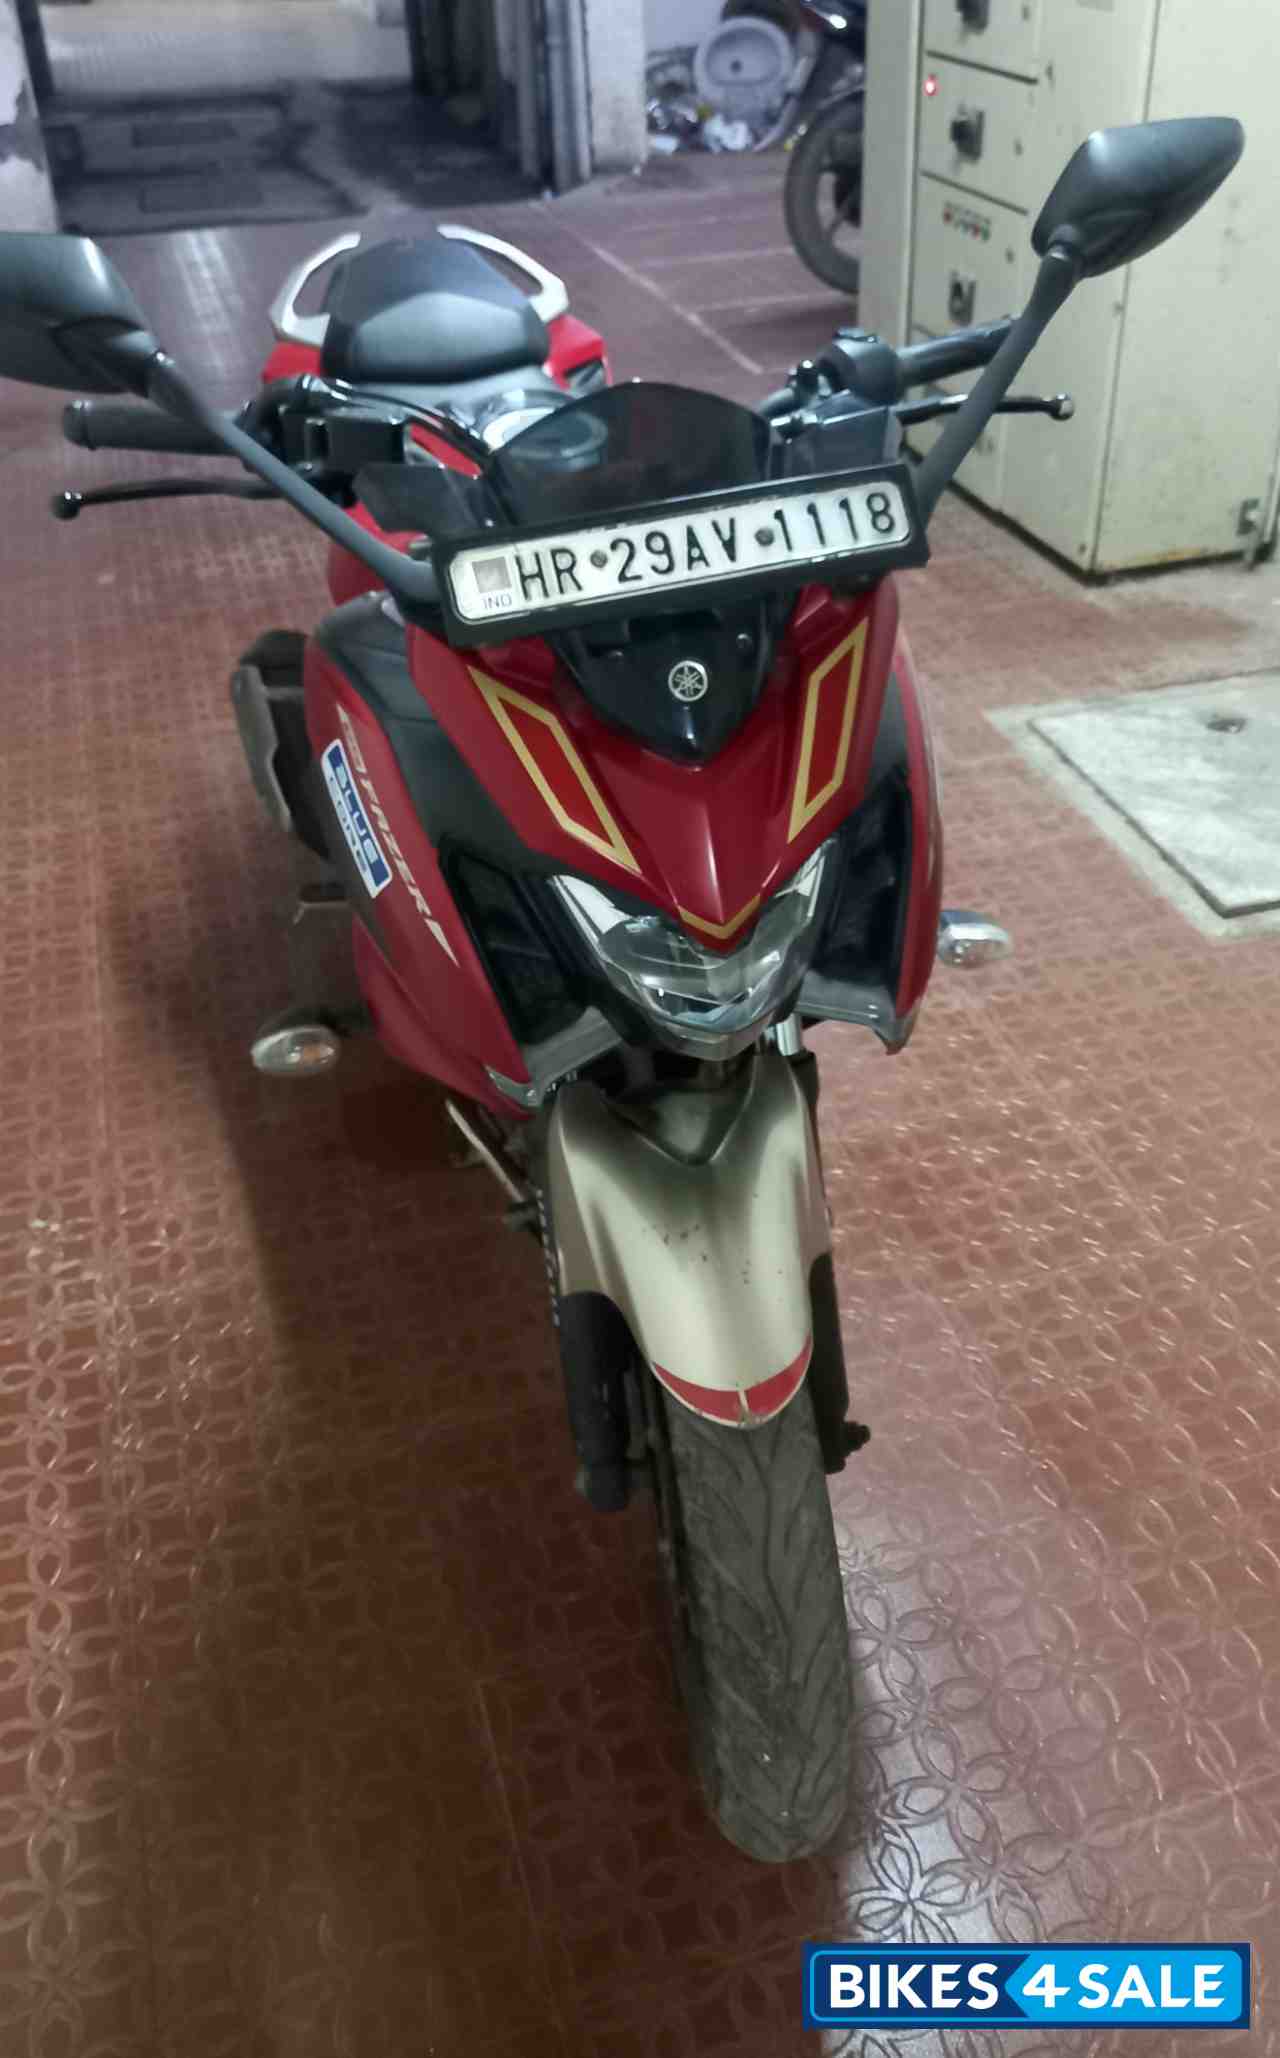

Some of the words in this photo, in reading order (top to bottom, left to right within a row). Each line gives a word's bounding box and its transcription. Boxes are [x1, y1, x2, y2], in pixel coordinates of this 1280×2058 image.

[514, 546, 583, 602] HR
[610, 518, 738, 584] 29AV
[772, 491, 895, 553] 1118
[481, 593, 513, 610] IND
